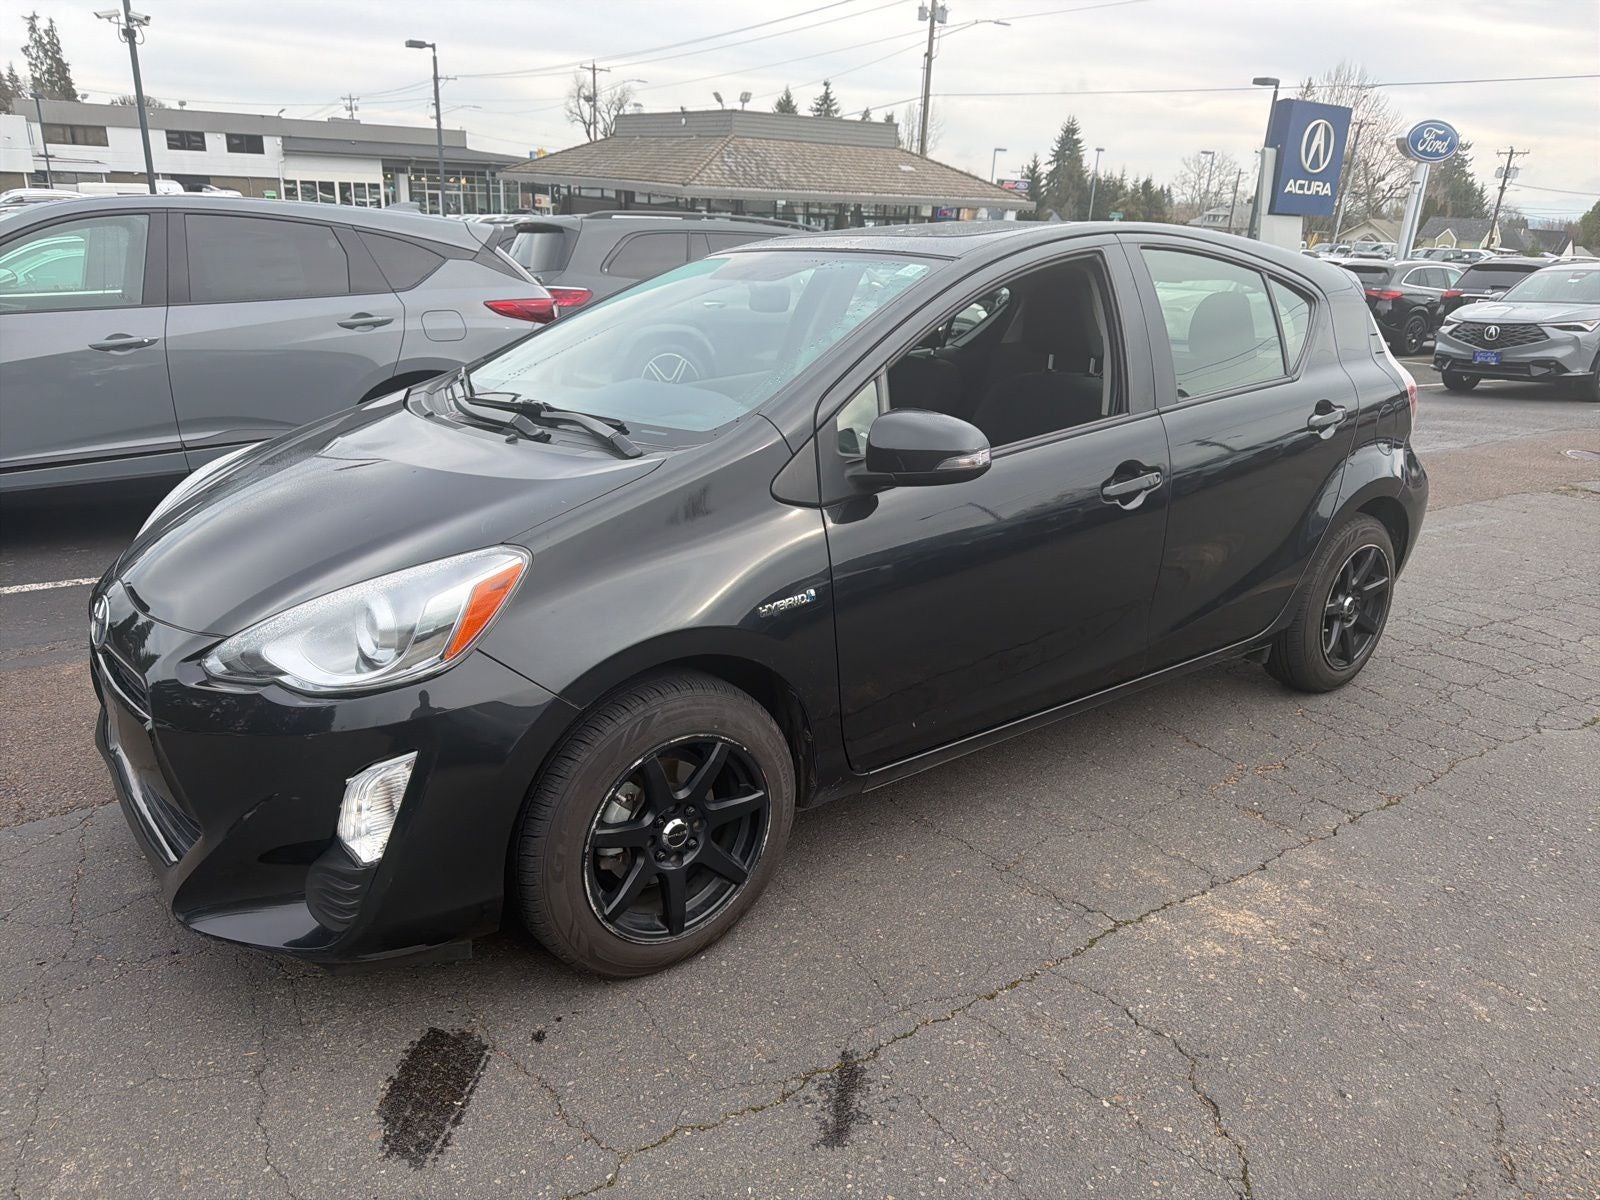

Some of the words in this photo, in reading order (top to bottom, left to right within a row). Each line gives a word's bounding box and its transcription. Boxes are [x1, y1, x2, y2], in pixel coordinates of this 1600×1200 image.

[1417, 127, 1452, 154] Ford
[1284, 179, 1332, 196] ACURA
[758, 593, 807, 617] HYBRID
